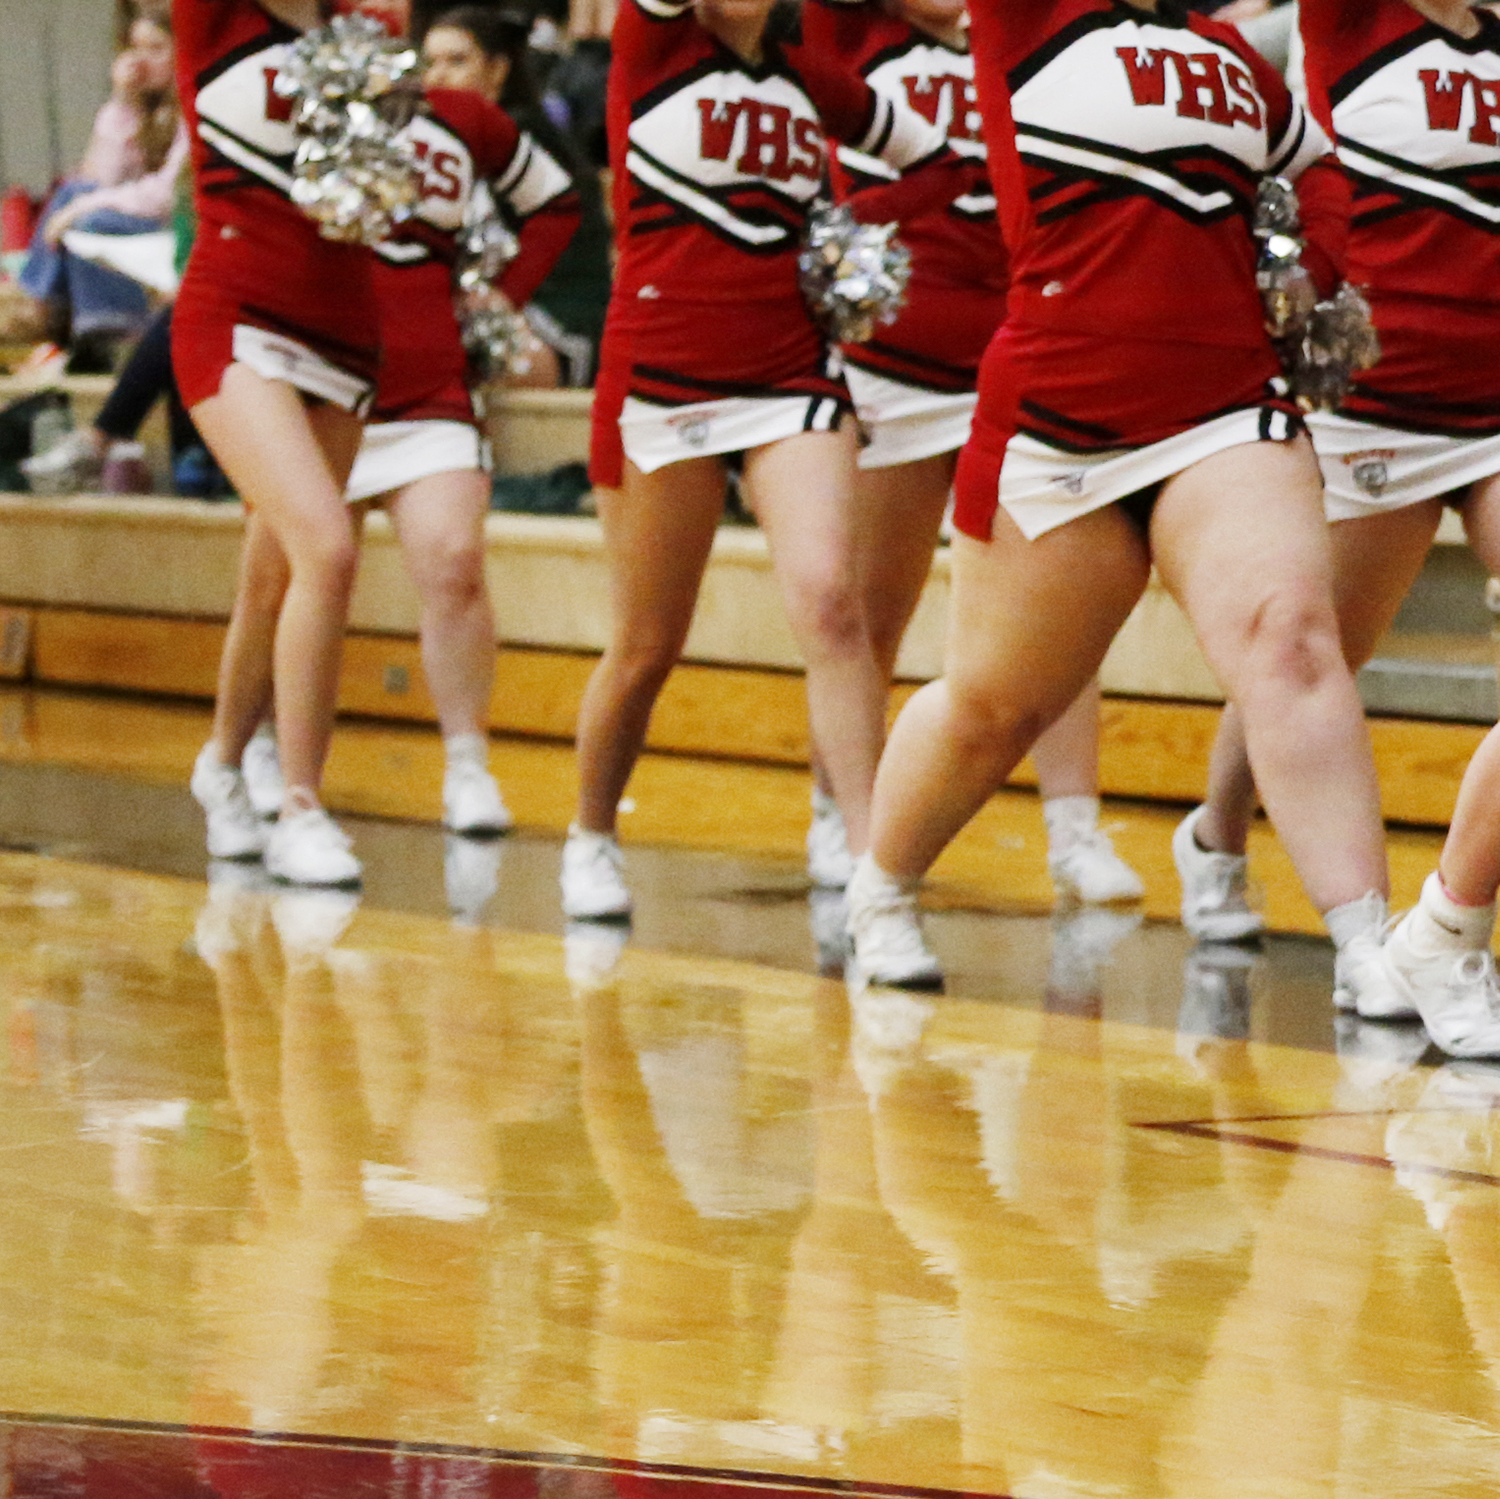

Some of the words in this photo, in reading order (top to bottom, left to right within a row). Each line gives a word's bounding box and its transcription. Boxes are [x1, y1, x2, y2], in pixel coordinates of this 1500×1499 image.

[902, 73, 986, 142] WH
[1115, 45, 1265, 132] WHS
[697, 97, 823, 182] WHS
